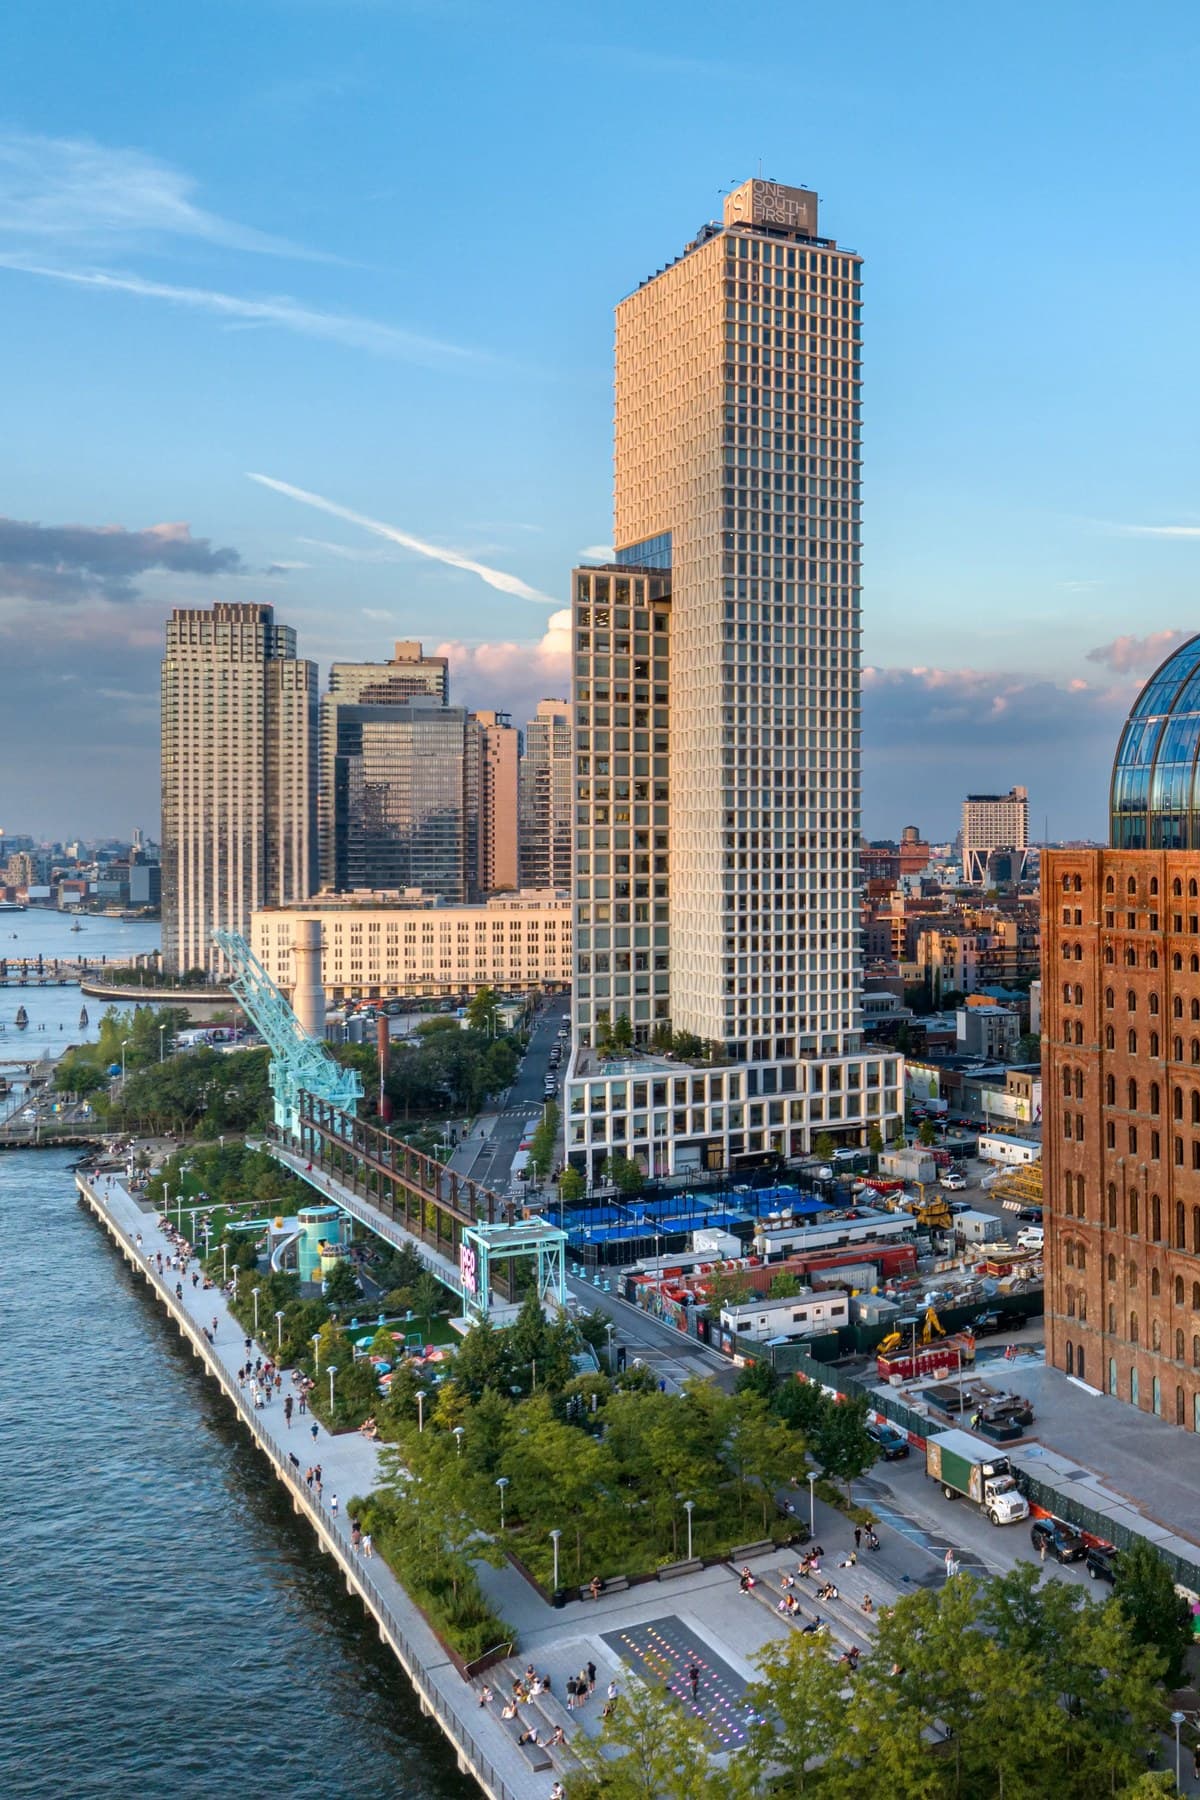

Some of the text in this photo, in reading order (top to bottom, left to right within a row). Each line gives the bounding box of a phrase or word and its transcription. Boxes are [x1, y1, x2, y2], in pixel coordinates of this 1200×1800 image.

[753, 180, 786, 199] ONE
[753, 193, 807, 216] SOUTH
[753, 206, 796, 225] FIRST
